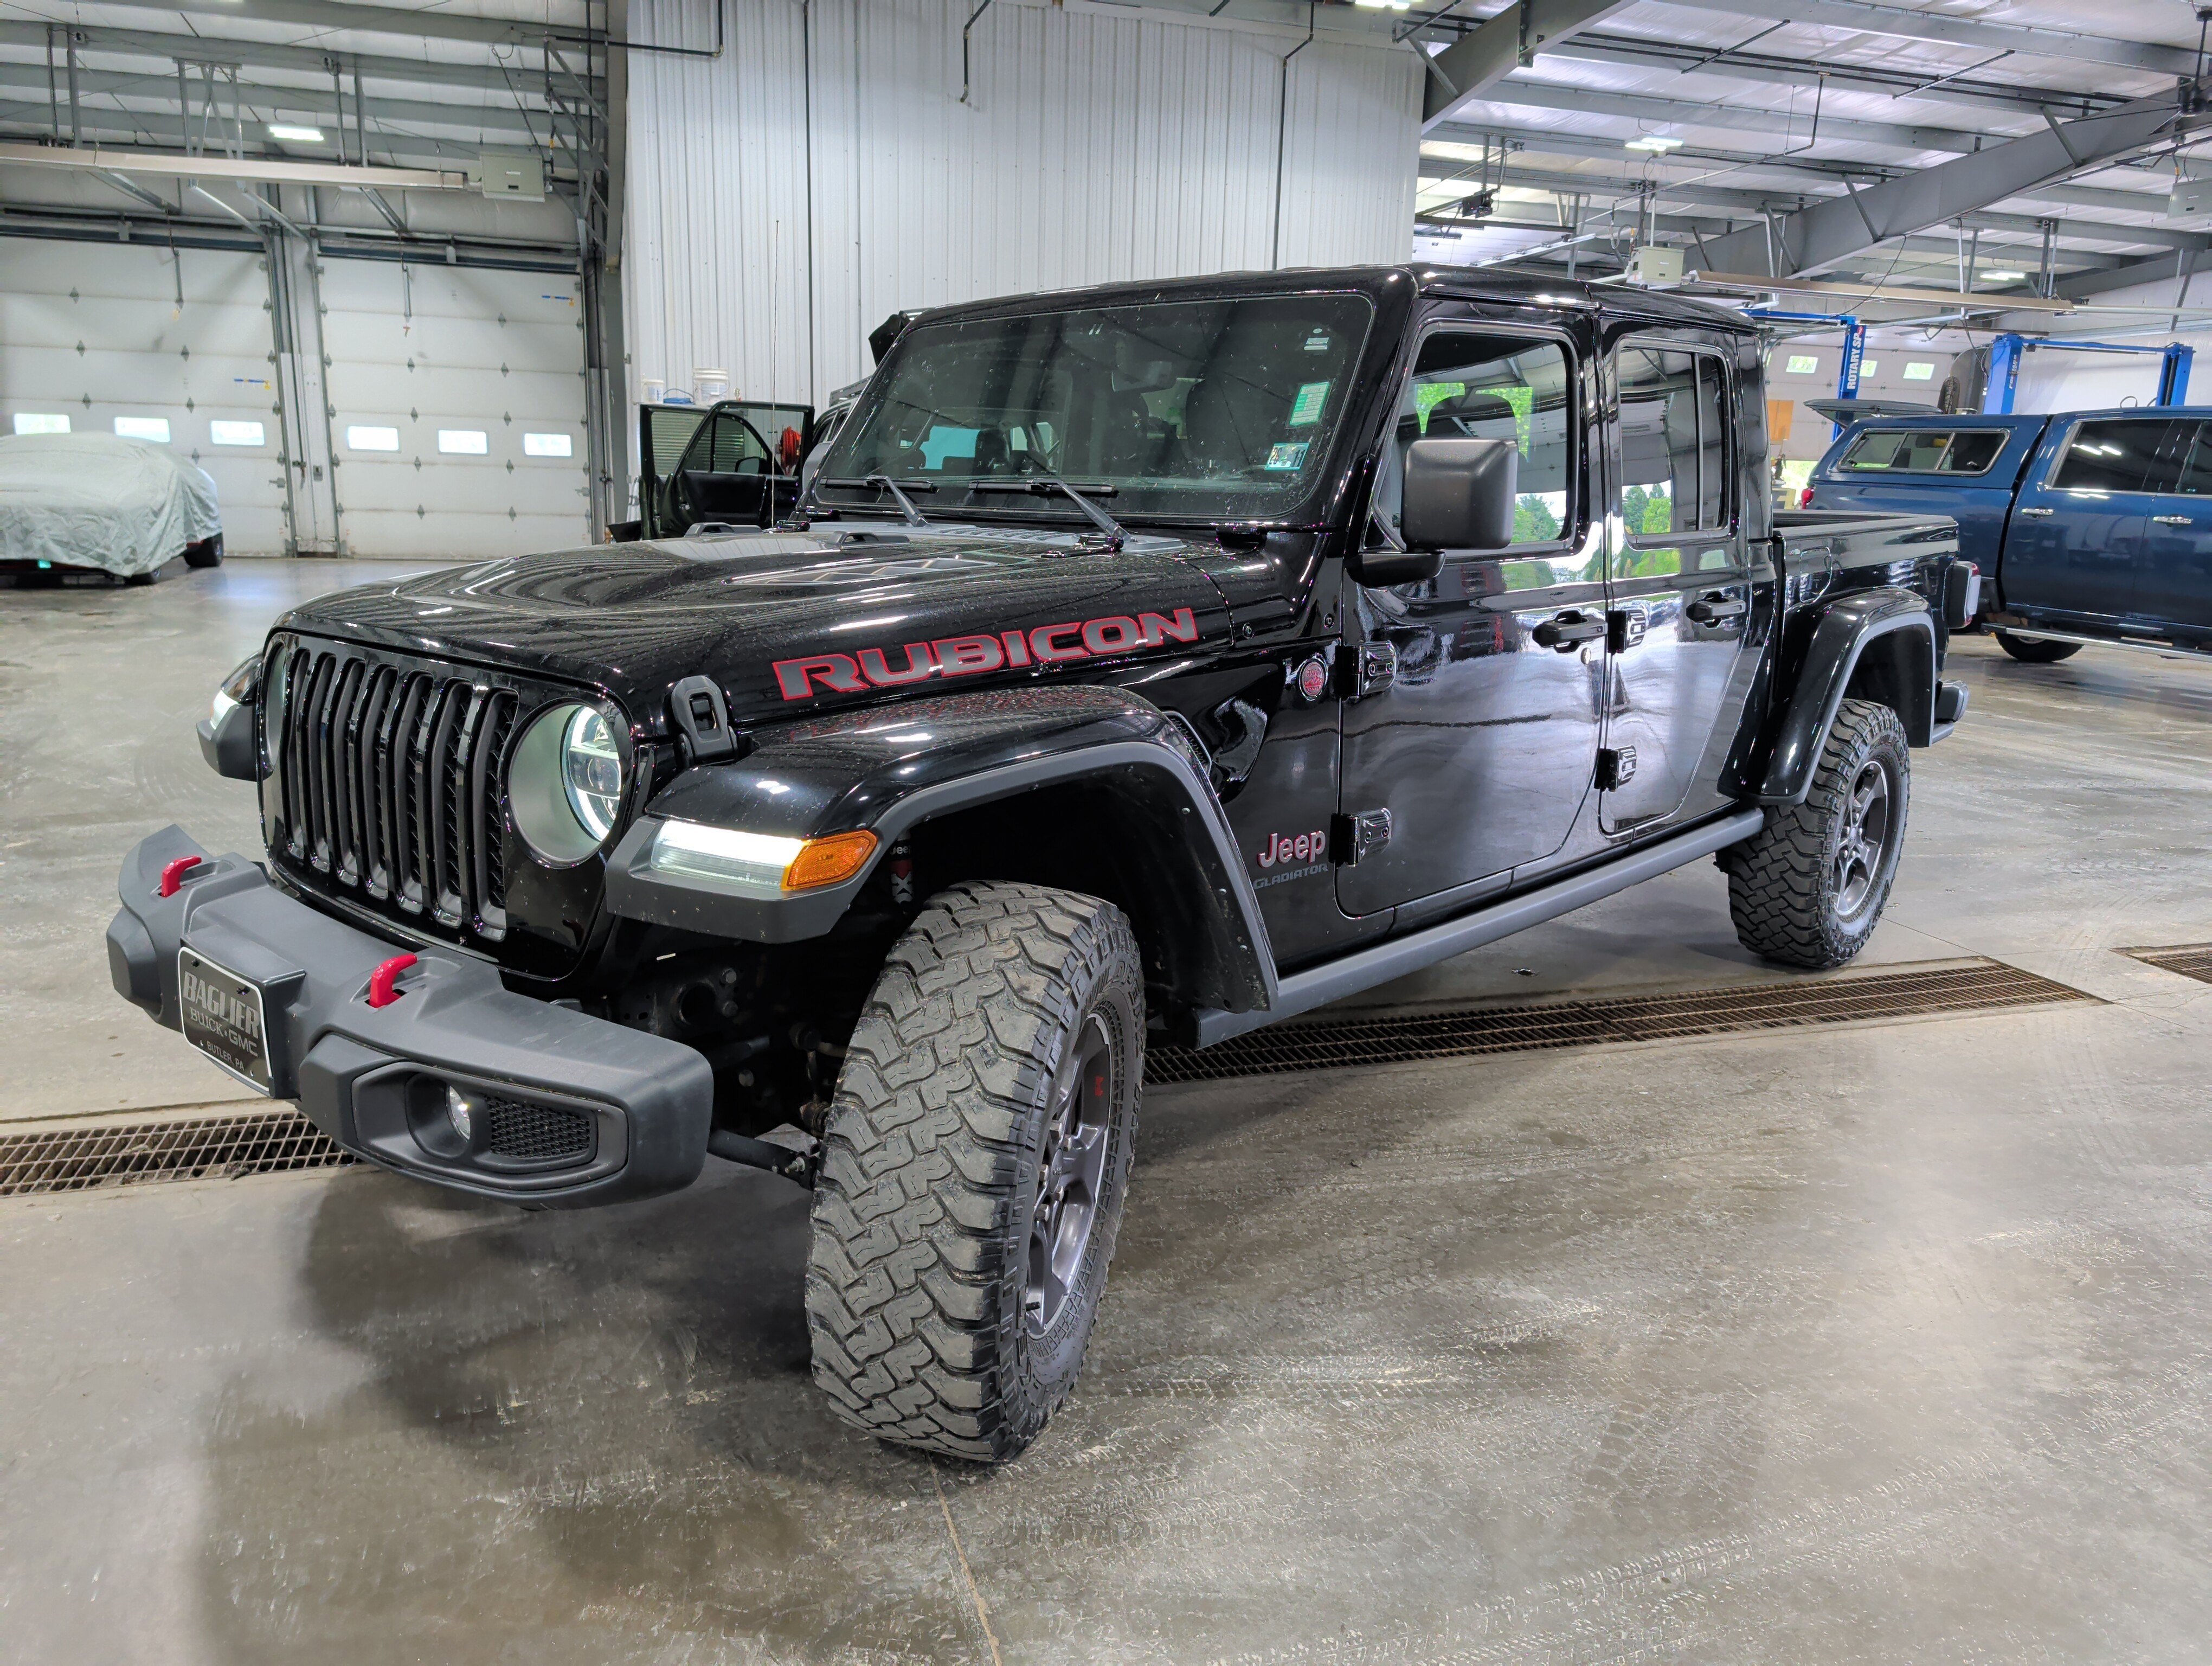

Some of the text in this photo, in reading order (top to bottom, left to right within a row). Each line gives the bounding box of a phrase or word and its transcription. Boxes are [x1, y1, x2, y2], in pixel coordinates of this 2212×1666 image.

[1853, 332, 1862, 348] SP
[1847, 348, 1861, 389] ROTARY
[772, 608, 1198, 701] RUBICON
[1257, 830, 1326, 868] Jeep
[1253, 862, 1328, 890] GLADIATOR
[182, 971, 260, 1039] BAGLIER
[190, 1007, 259, 1057] BUICK GMC
[235, 1058, 245, 1071] PA
